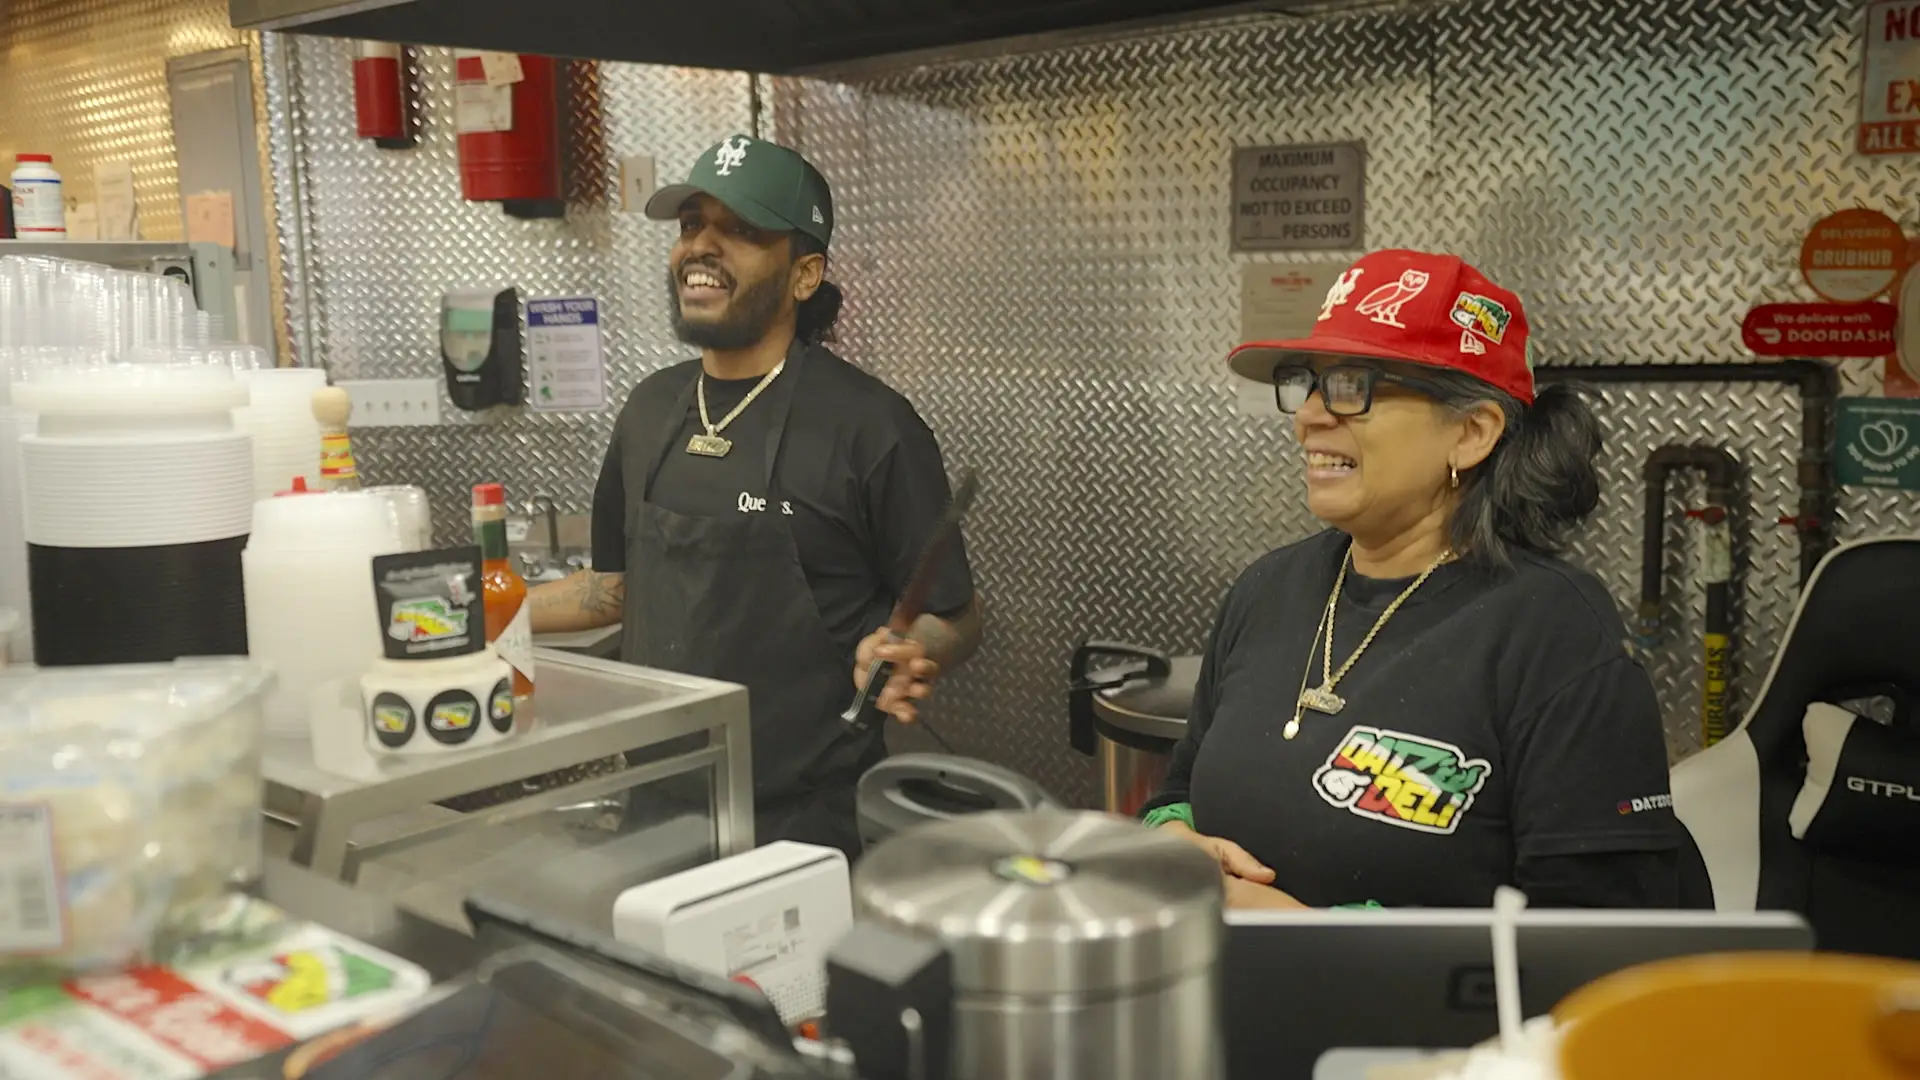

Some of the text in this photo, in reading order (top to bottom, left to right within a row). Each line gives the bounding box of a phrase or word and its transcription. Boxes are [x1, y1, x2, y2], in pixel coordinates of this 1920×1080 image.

[1866, 127, 1905, 149] ALL
[1259, 150, 1335, 168] MAXIMUM
[1249, 174, 1340, 193] OCCUPANCY
[1240, 198, 1352, 216] NOT TO EXCEED
[1282, 222, 1351, 239] PERSONS
[1812, 248, 1893, 266] GRUBHUB
[1843, 312, 1872, 324] with
[1787, 328, 1891, 343] DOORDASH
[1707, 647, 1726, 681] GAS
[1846, 776, 1920, 802] GTPL
[1356, 774, 1467, 828] DELI
